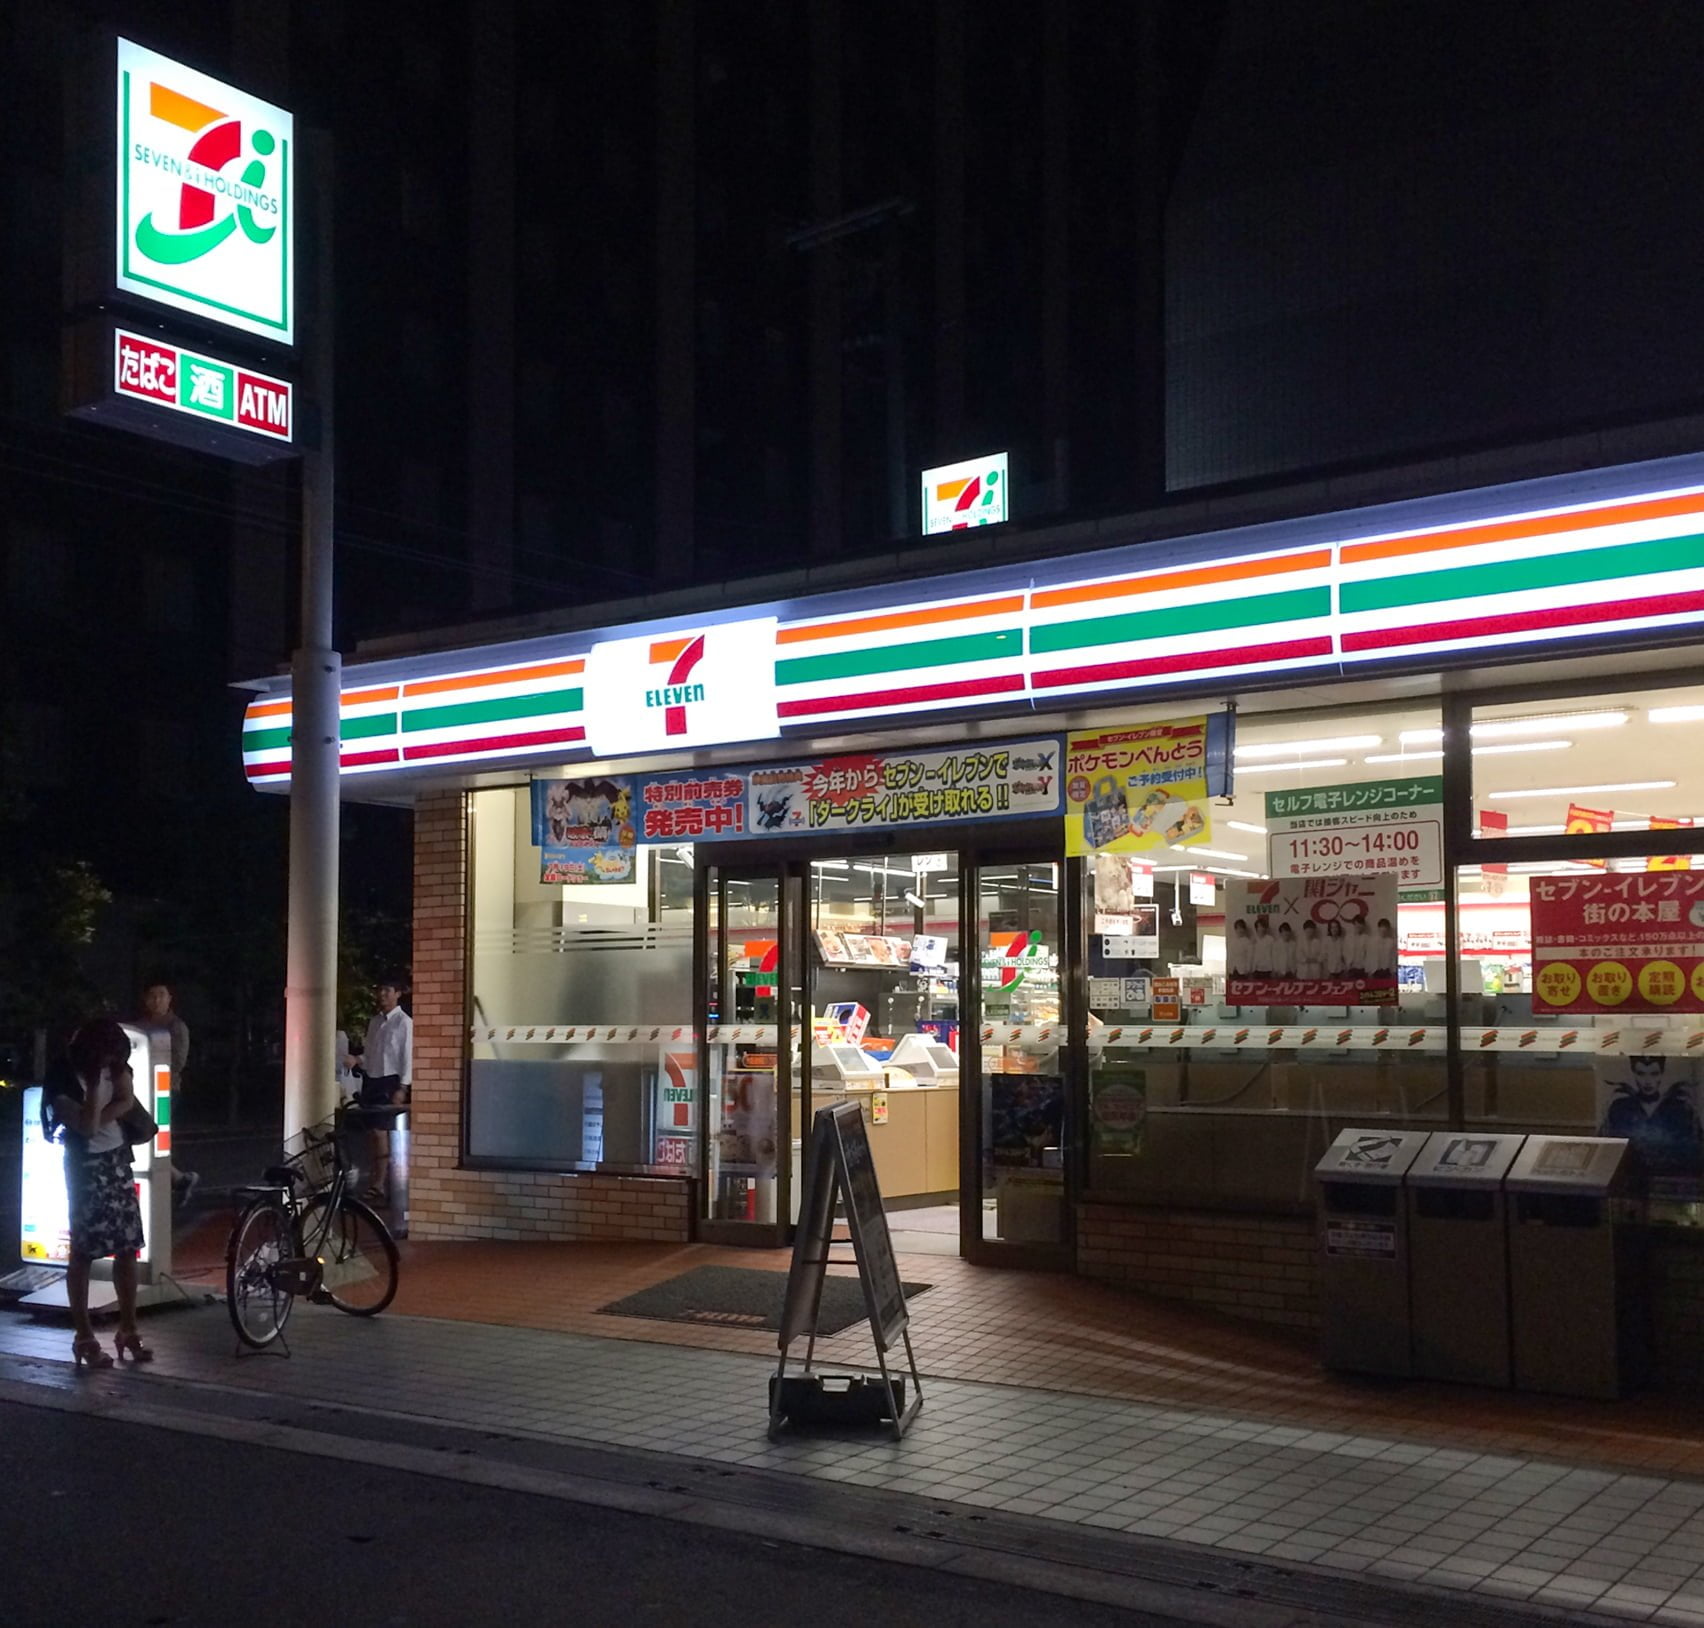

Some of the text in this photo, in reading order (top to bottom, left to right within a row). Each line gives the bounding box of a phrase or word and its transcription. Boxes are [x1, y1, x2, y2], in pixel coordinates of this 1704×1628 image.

[134, 143, 183, 177] SEVEN
[204, 173, 278, 215] HOLDINGS
[121, 345, 288, 428] たばこ 酒 ATM
[1068, 740, 1203, 773] ポケモンべんとう
[644, 778, 743, 803] 特別前売券
[813, 767, 879, 797] 今年から
[1272, 784, 1435, 812] セルフ電子レンジコーナー
[1289, 856, 1420, 874] 電子レンジでの商品温めを
[1303, 876, 1376, 898] 関ジャニ
[1582, 900, 1681, 925] 街の本屋
